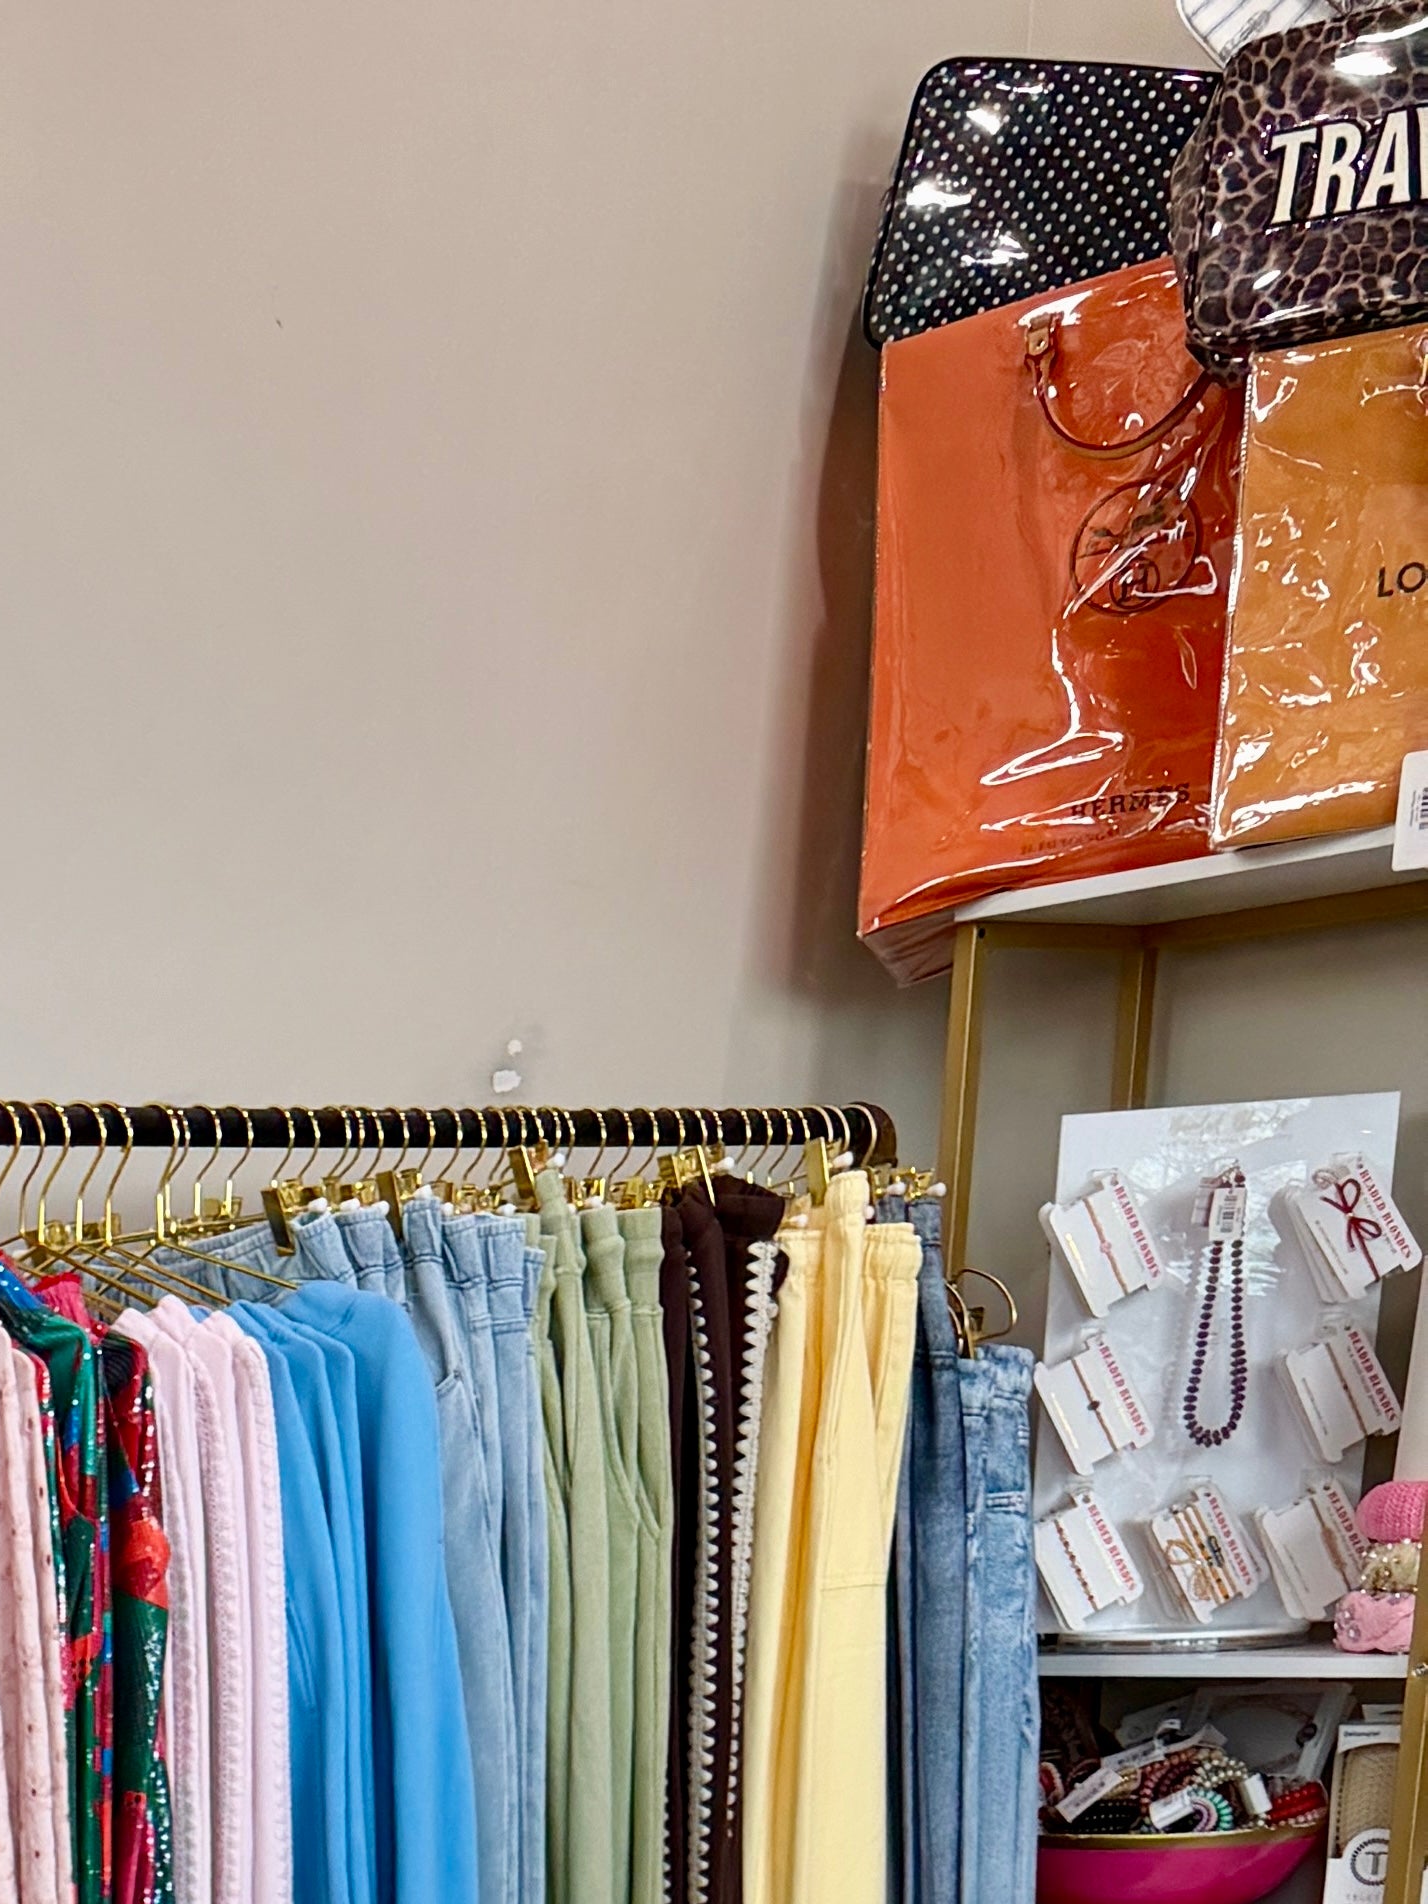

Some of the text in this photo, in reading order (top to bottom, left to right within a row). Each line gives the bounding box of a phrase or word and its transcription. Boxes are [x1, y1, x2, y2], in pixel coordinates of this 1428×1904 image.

[1270, 108, 1428, 225] TRA
[1359, 1169, 1387, 1212] BEADED
[1348, 1331, 1375, 1373] BEADED
